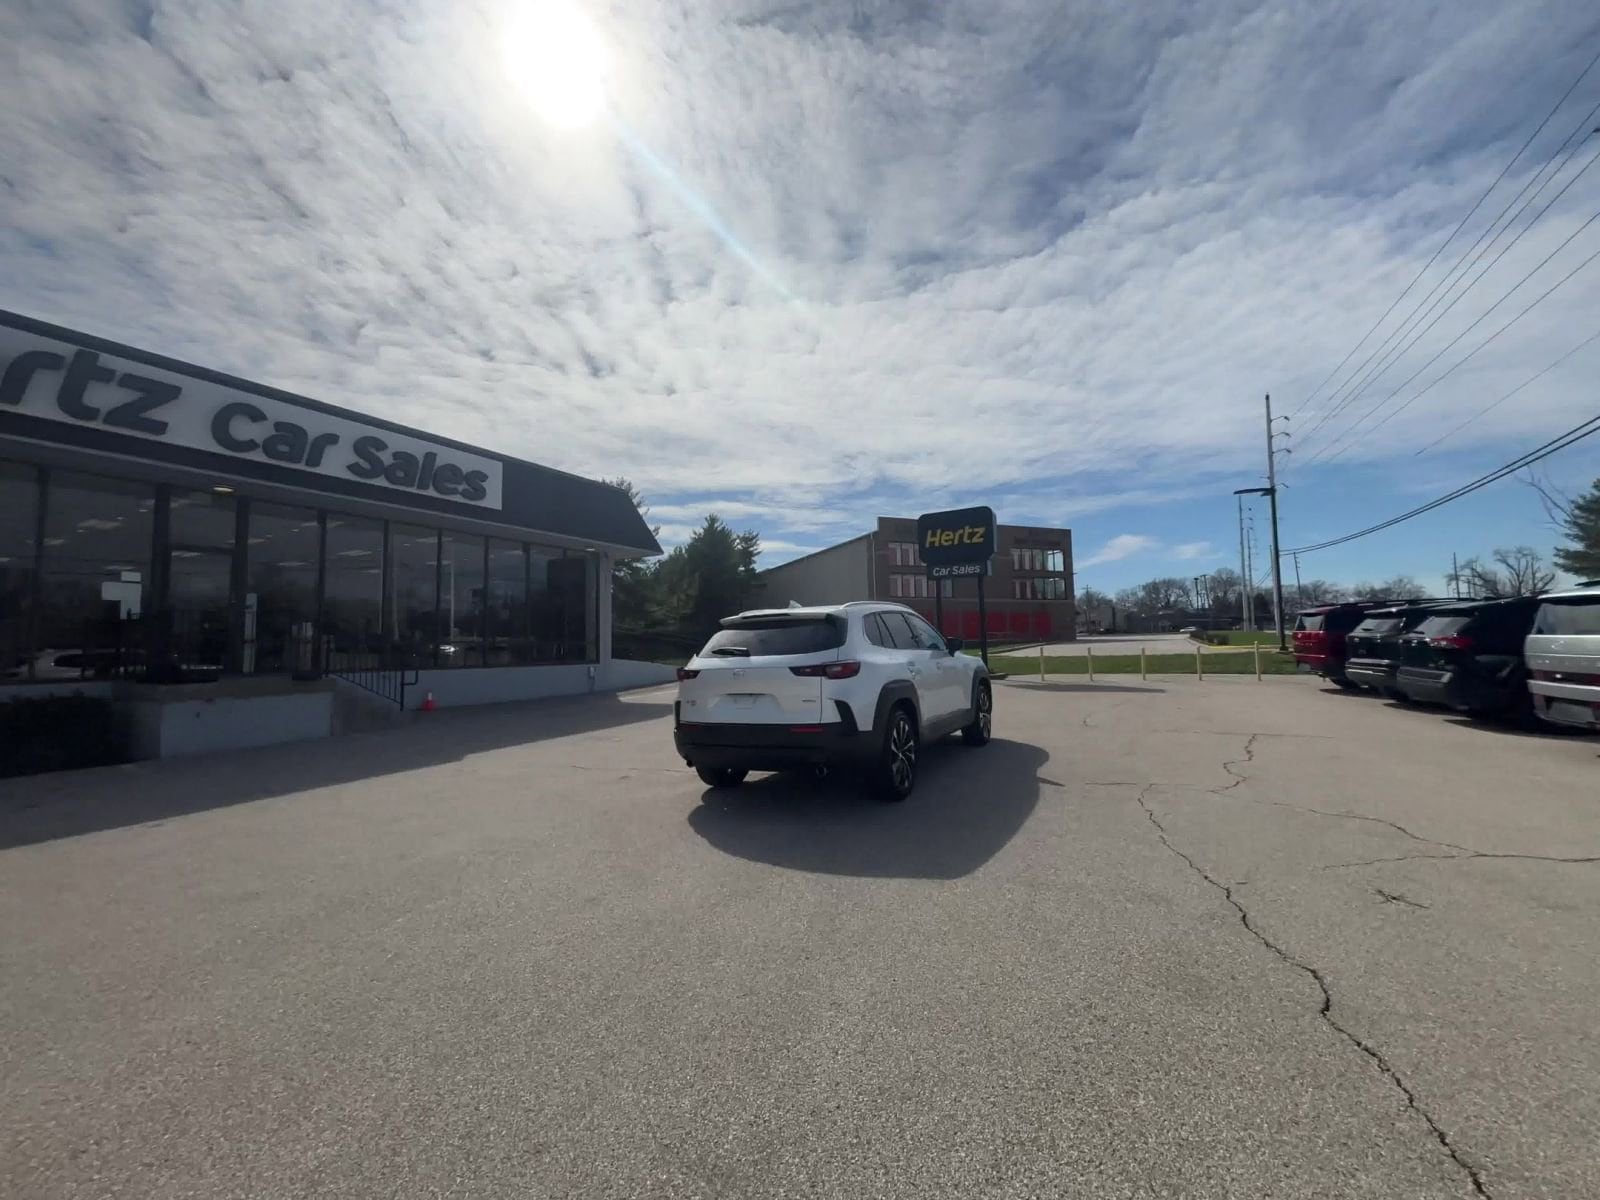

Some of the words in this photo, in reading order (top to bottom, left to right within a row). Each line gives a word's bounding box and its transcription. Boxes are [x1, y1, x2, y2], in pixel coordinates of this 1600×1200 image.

[211, 402, 339, 467] Car
[346, 436, 488, 501] Sales
[926, 526, 985, 548] Hertz
[932, 566, 950, 577] Car
[952, 565, 981, 575] Sales
